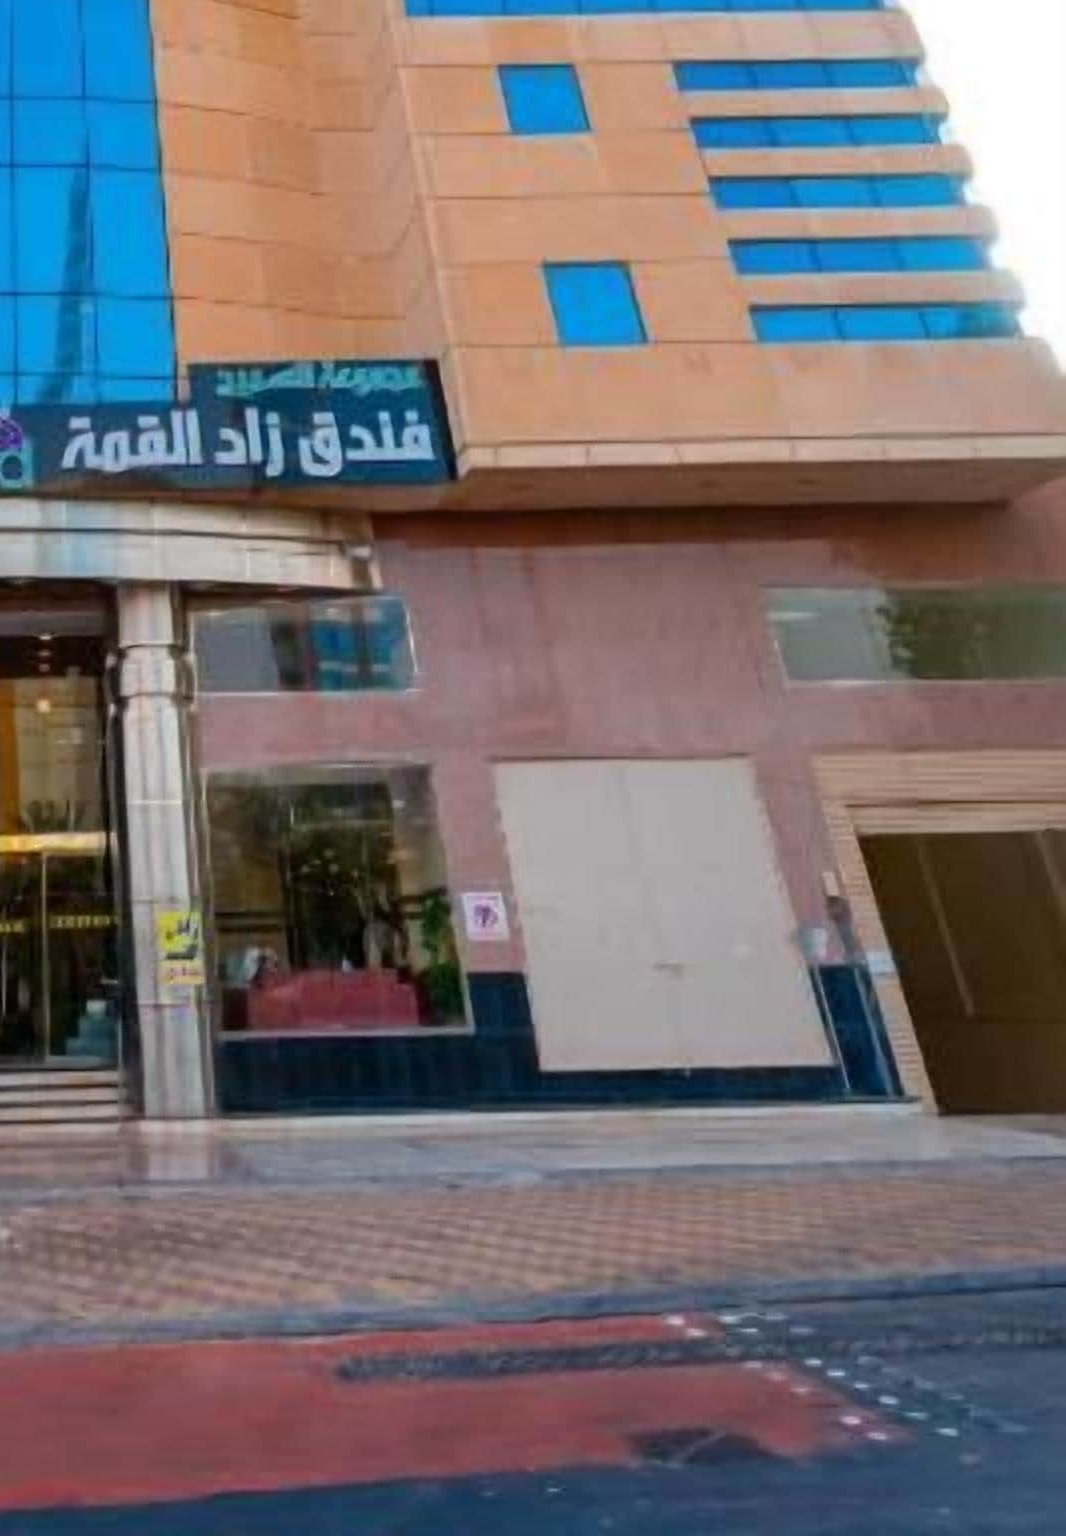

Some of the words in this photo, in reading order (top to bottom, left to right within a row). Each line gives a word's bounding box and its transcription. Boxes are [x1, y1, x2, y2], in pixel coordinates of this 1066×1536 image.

[61, 407, 203, 474] القمة
[214, 406, 284, 478] زاد
[298, 409, 436, 477] فندق
